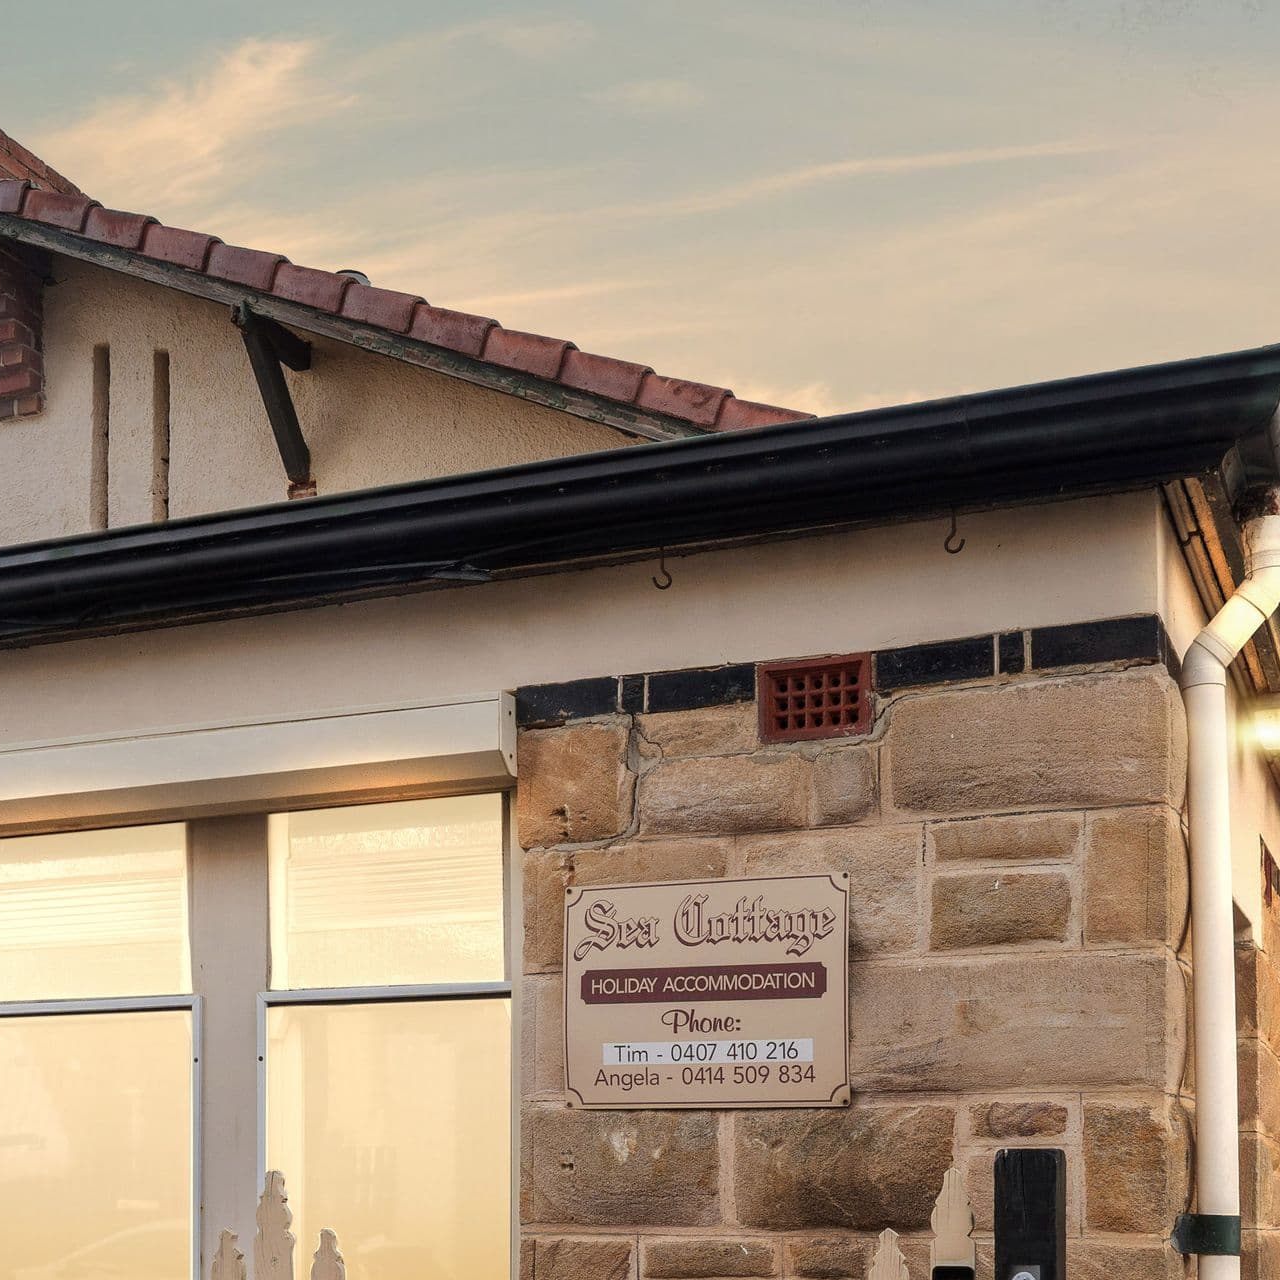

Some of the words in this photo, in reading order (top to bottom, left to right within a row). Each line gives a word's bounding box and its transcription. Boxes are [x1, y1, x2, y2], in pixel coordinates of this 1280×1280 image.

[573, 898, 660, 962] Sea
[673, 892, 837, 957] Cottage
[591, 976, 658, 995] HOLIDAY
[662, 971, 816, 993] ACCOMMODATION
[661, 1008, 741, 1034] Phone:
[613, 1044, 649, 1063] Tim
[670, 1043, 718, 1062] 0407
[726, 1042, 758, 1061] 410
[765, 1041, 799, 1060] 216
[594, 1066, 660, 1091] Angela
[681, 1066, 725, 1085] 0414
[733, 1065, 770, 1084] 509
[778, 1064, 816, 1083] 834
